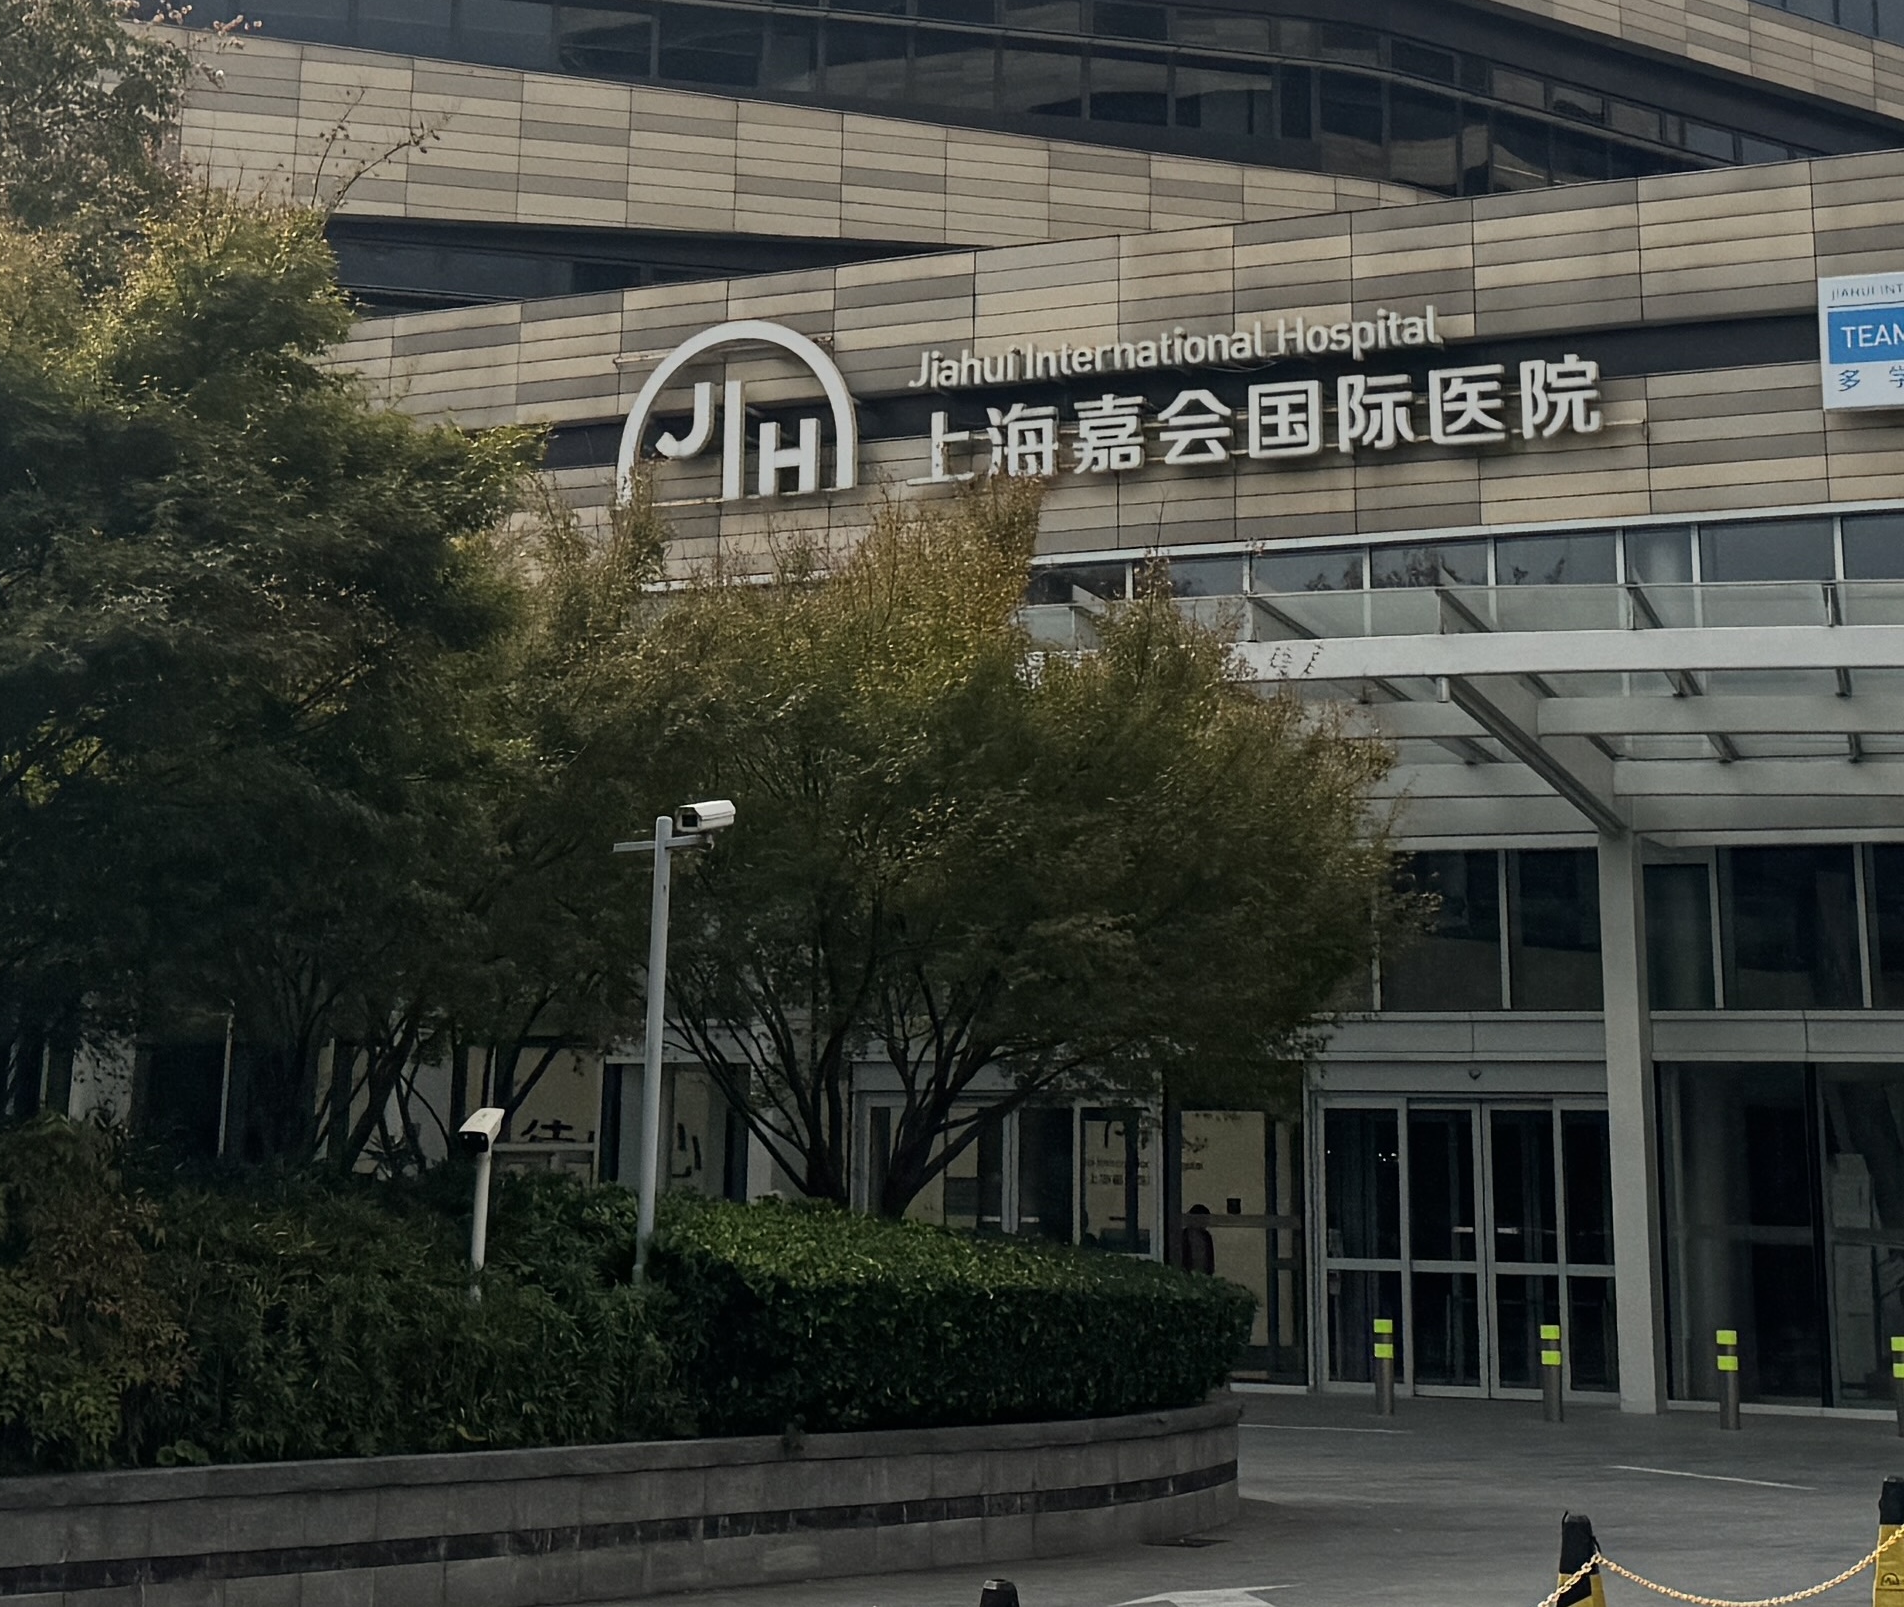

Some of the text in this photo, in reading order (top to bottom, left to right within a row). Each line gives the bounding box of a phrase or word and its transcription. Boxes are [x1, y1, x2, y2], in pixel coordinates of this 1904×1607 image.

[1831, 285, 1876, 300] JIAHUI
[908, 305, 1441, 389] Jiahui International Hospital
[906, 353, 1603, 487] 上海嘉会国际医院
